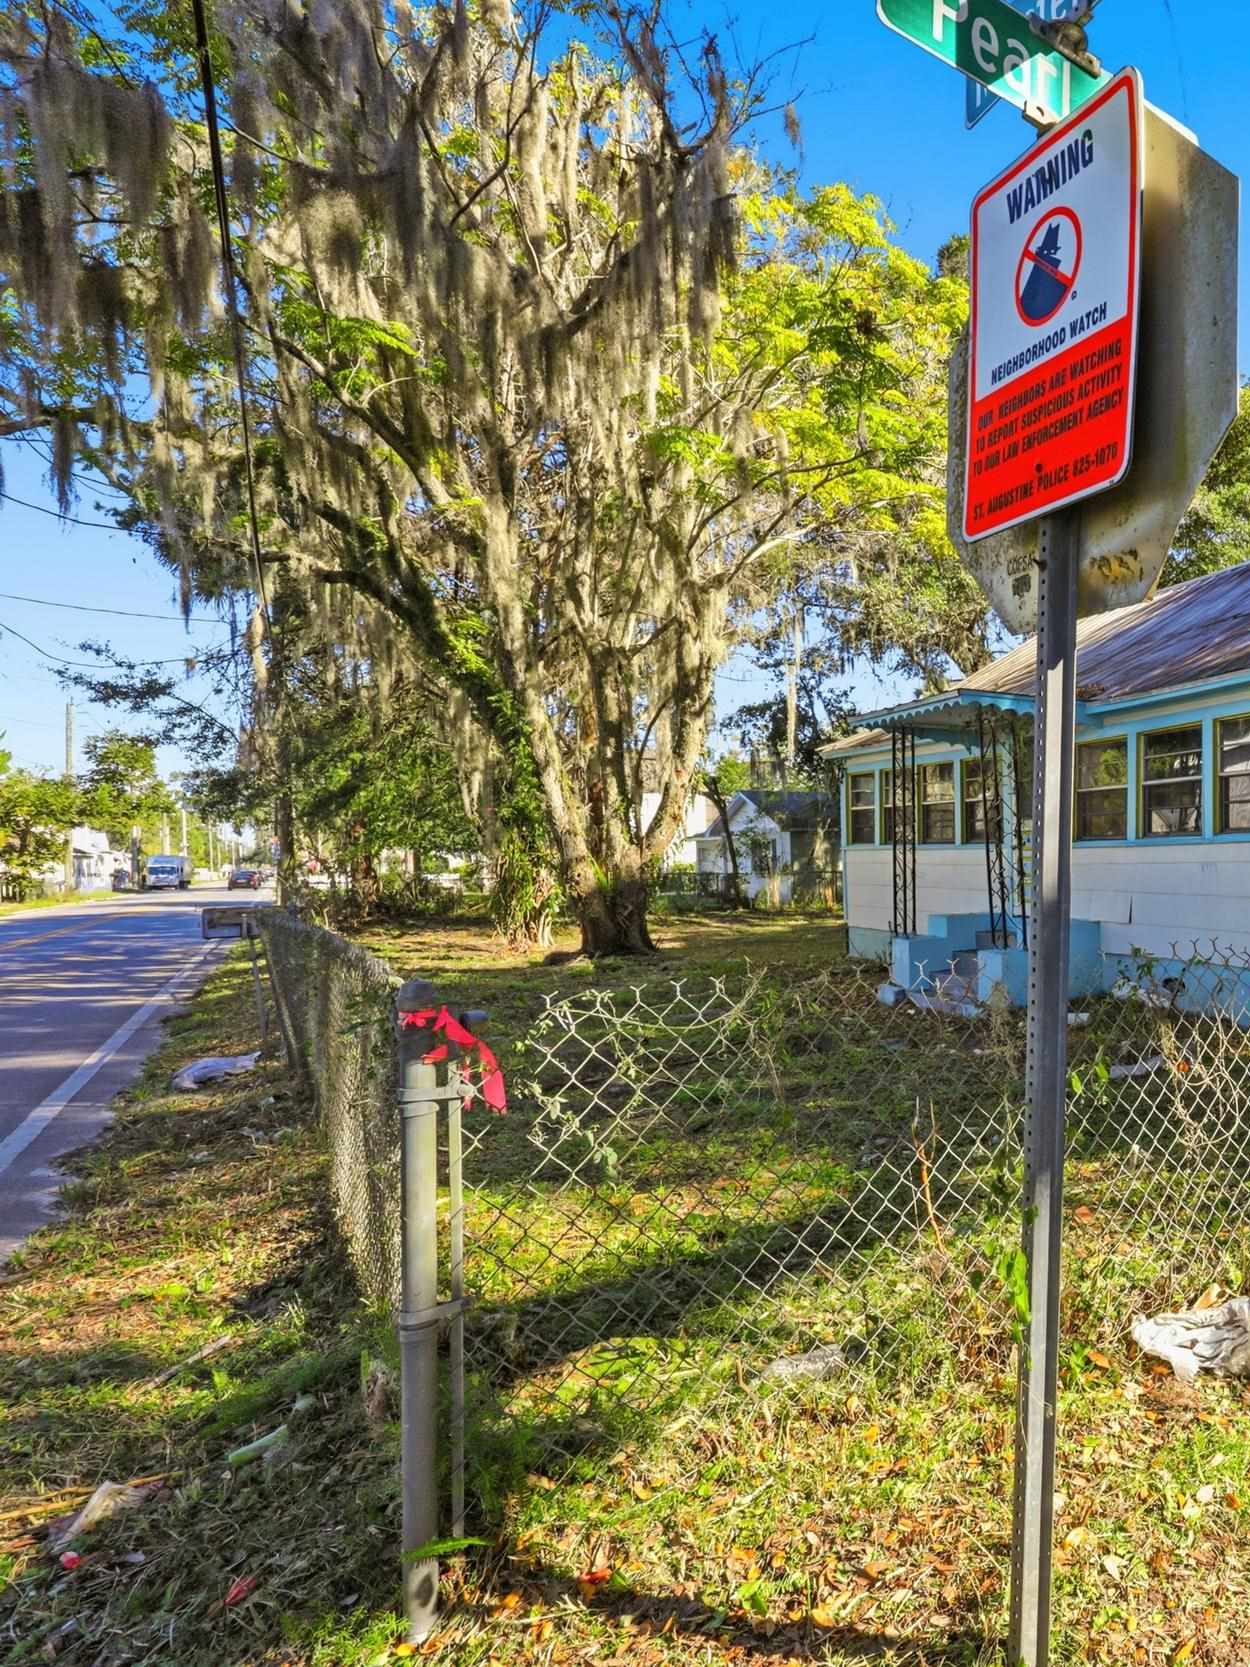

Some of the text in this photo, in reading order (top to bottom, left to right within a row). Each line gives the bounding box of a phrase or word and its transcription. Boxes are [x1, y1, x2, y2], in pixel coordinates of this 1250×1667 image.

[1006, 128, 1094, 225] WARNING
[991, 301, 1108, 386] NEIGHBORHOOD WATCH
[998, 379, 1046, 420] NEIGHBORS
[1048, 367, 1067, 391] ARE
[1070, 337, 1122, 380] WATCHING
[973, 387, 1124, 478] TO OUR LAW ENFORCEMENT AGENCY
[975, 362, 1123, 455] TO REPORT SUSPICIOUS ACTIVITY
[973, 503, 985, 522] ST.
[987, 479, 1034, 515] AUGUSTINE
[1036, 464, 1070, 493] POLICE
